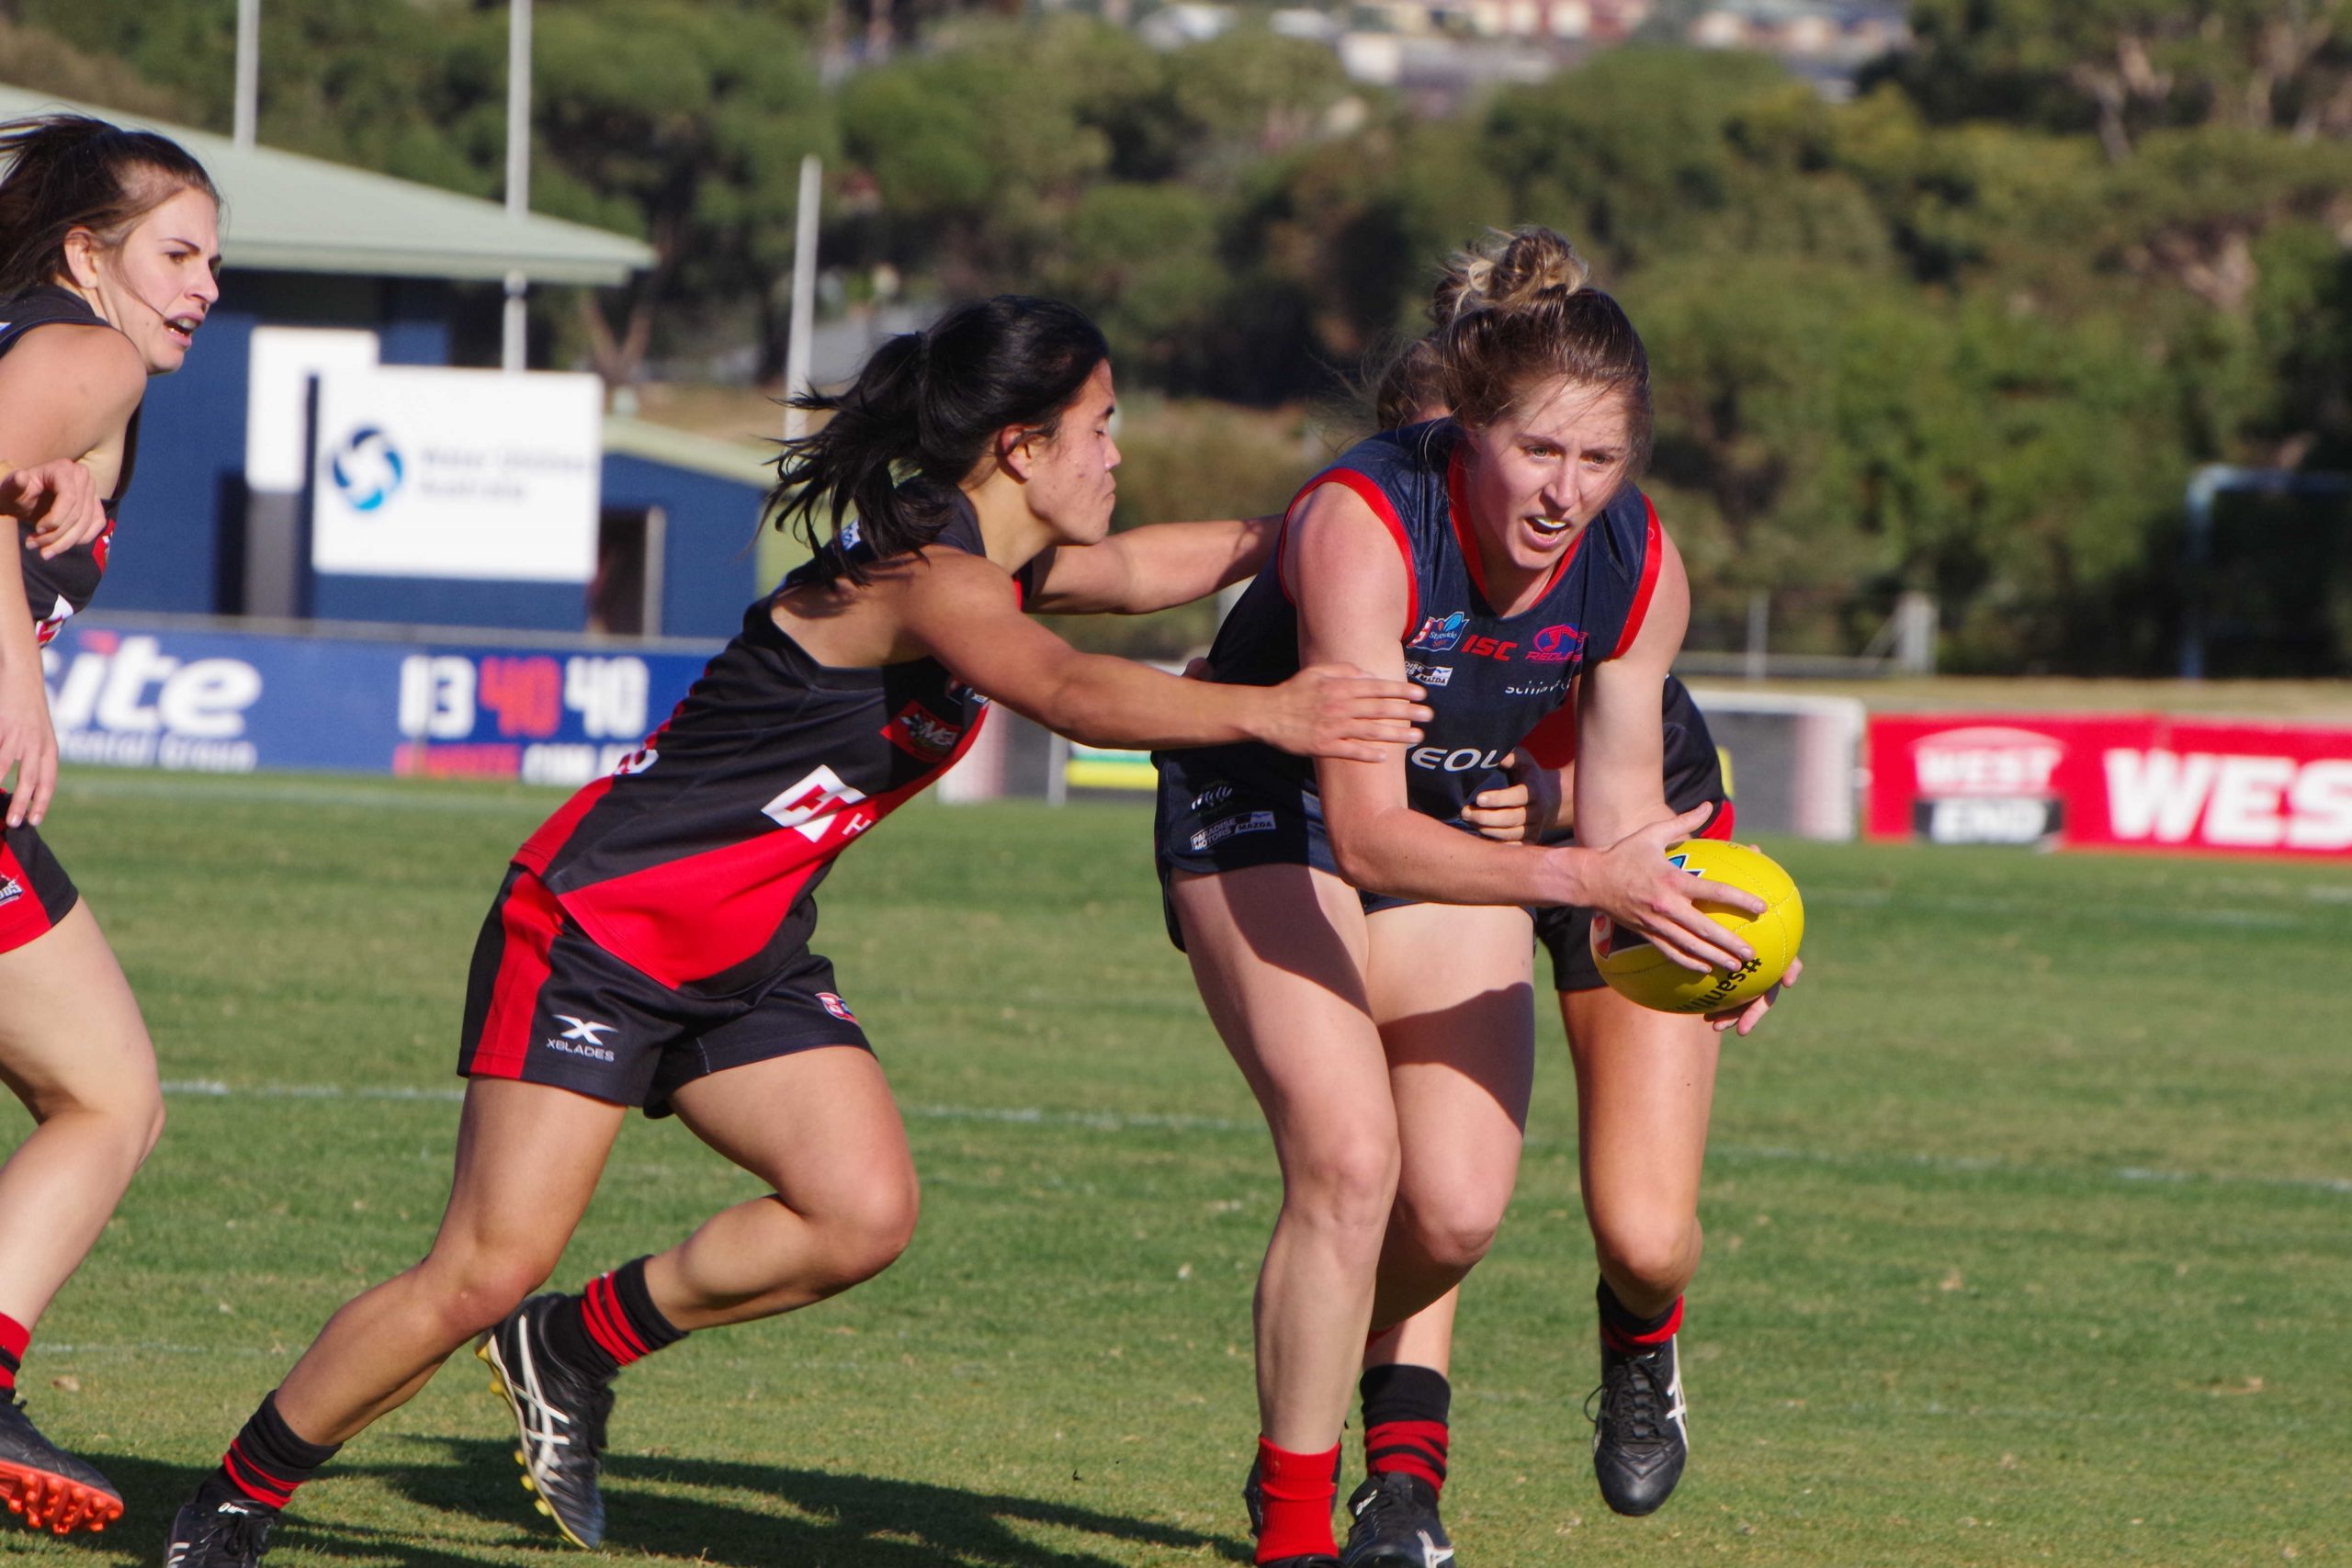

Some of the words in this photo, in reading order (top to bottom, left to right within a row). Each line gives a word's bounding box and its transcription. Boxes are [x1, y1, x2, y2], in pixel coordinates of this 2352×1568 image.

[1460, 634, 1518, 661] ISC
[398, 654, 477, 739] 13
[479, 655, 563, 739] 40
[564, 655, 650, 739] 40
[1193, 818, 1237, 845] PARADISE
[546, 1037, 616, 1063] XBLADES
